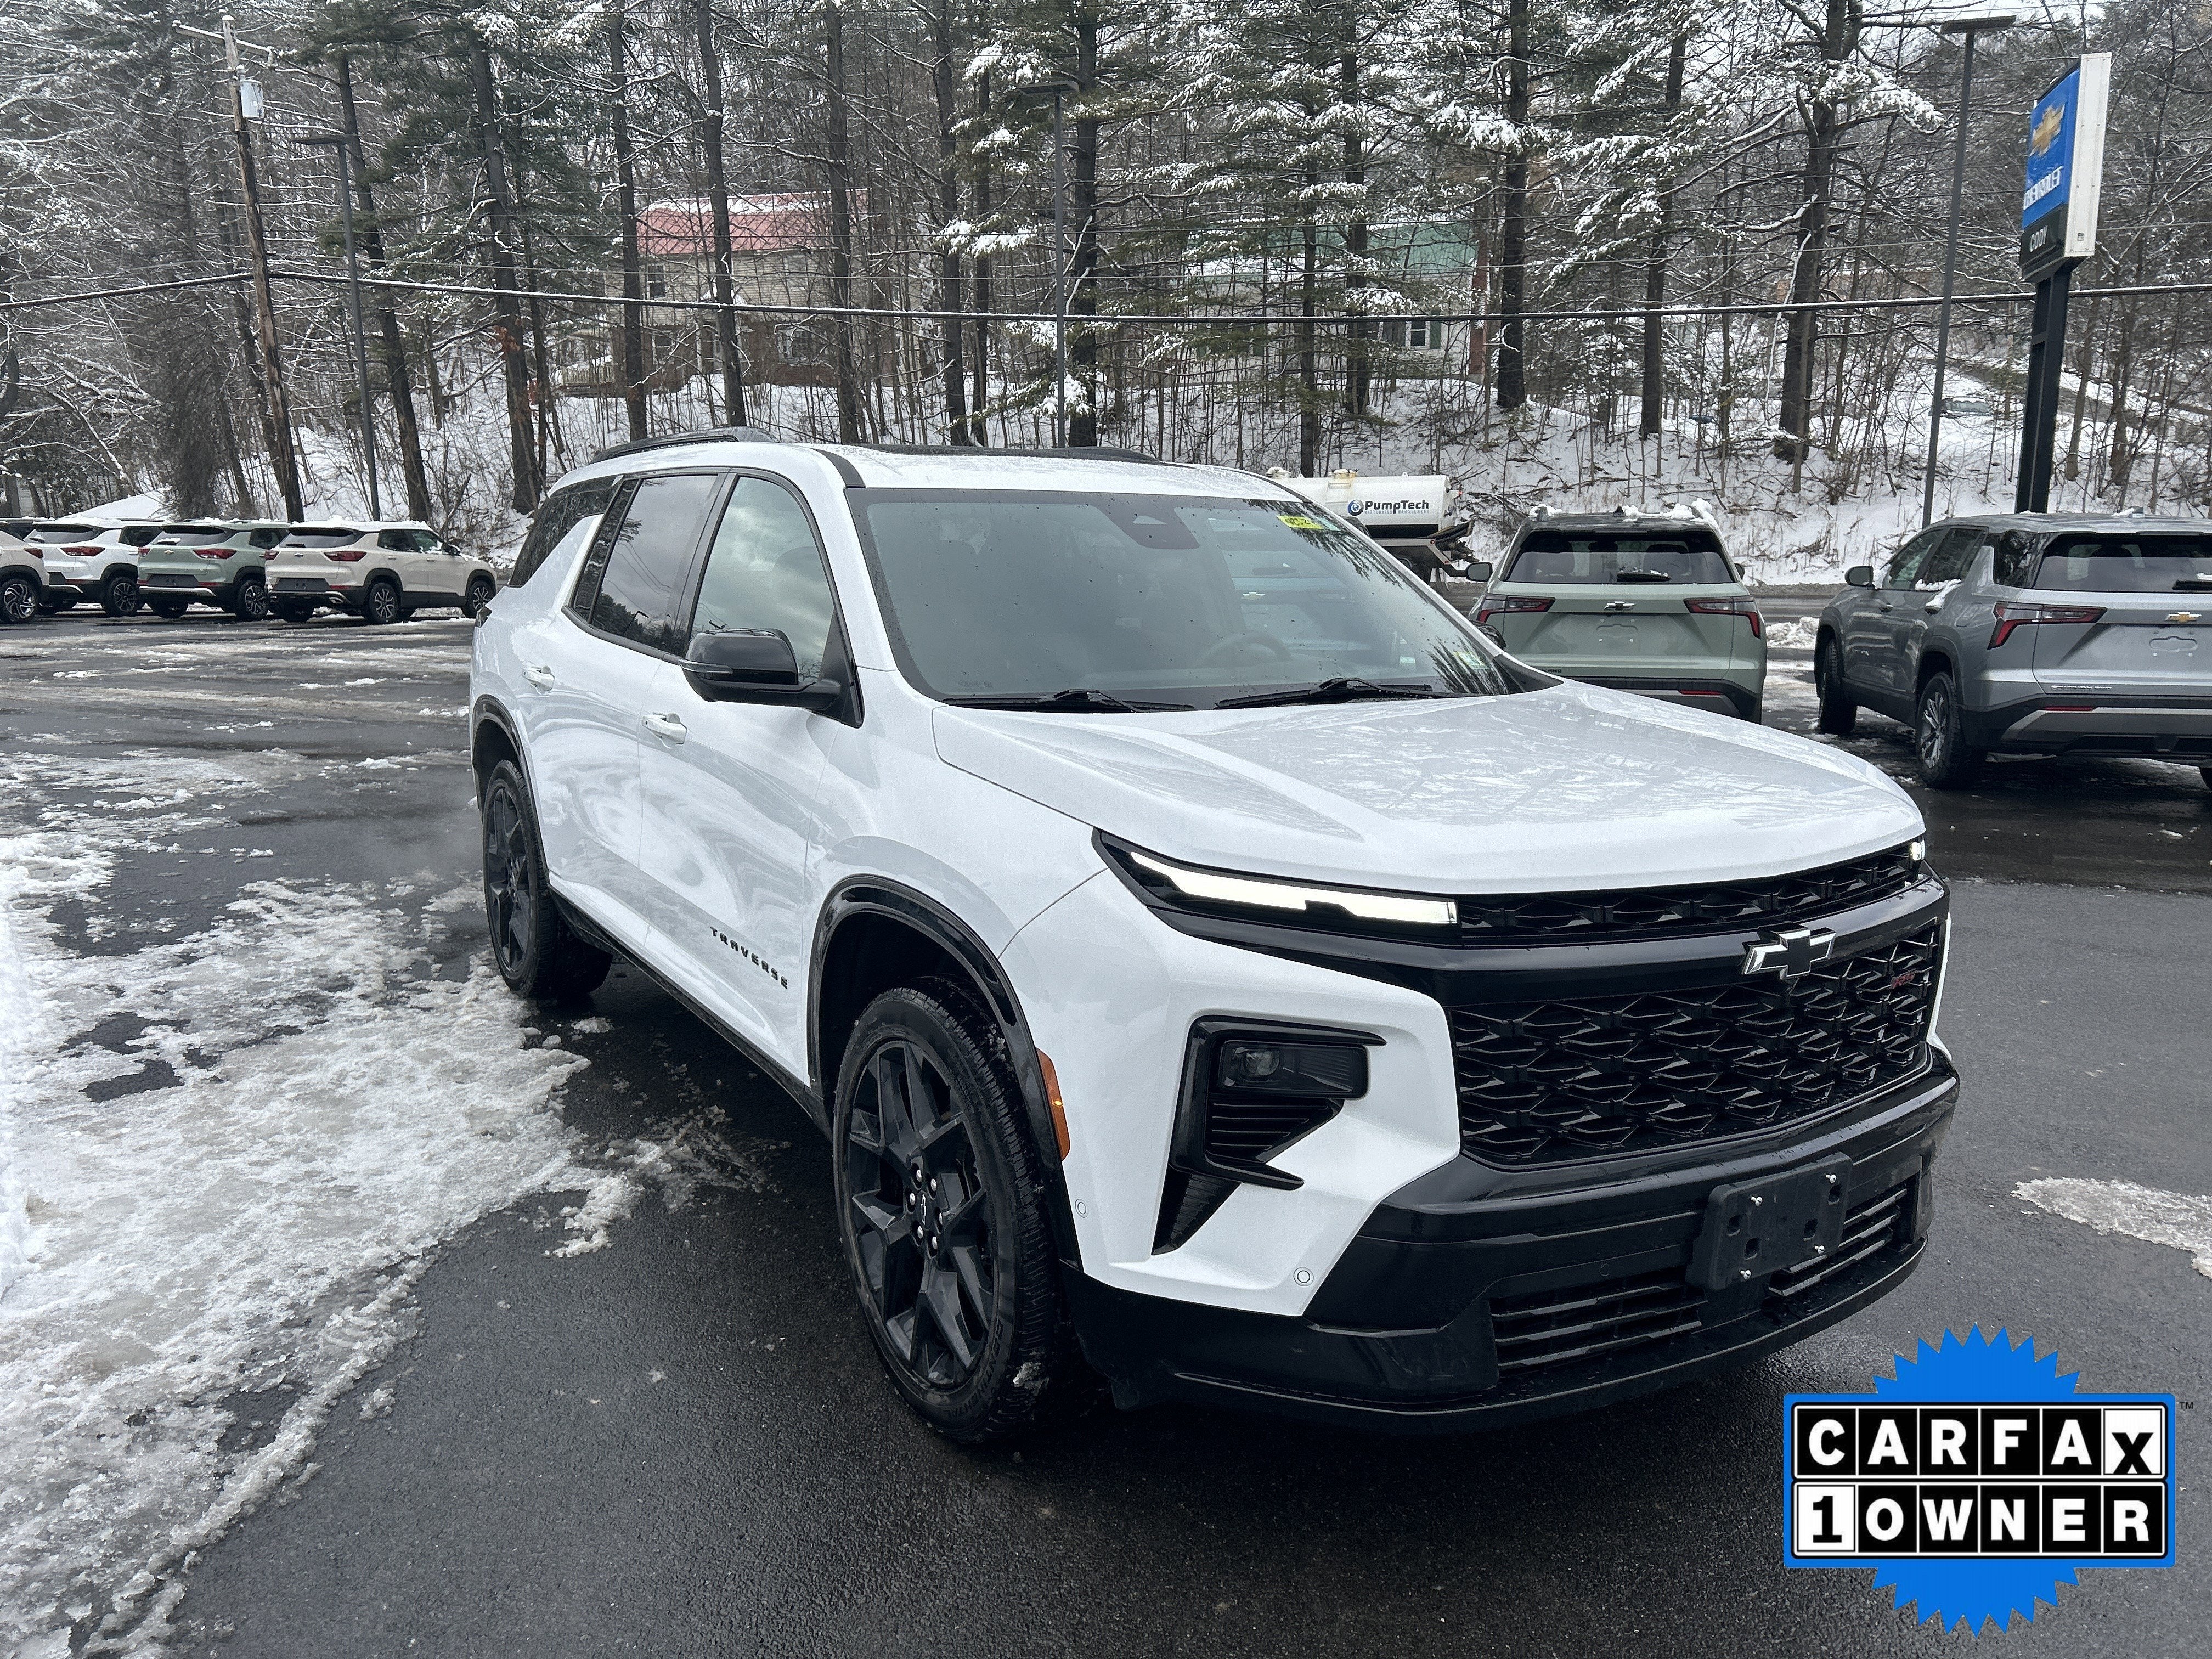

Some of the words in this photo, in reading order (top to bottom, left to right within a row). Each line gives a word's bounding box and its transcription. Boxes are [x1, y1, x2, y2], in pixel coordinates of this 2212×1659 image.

[2030, 225, 2048, 252] CODY
[1365, 499, 1429, 514] PumpTech
[710, 926, 788, 989] TRAVERSE
